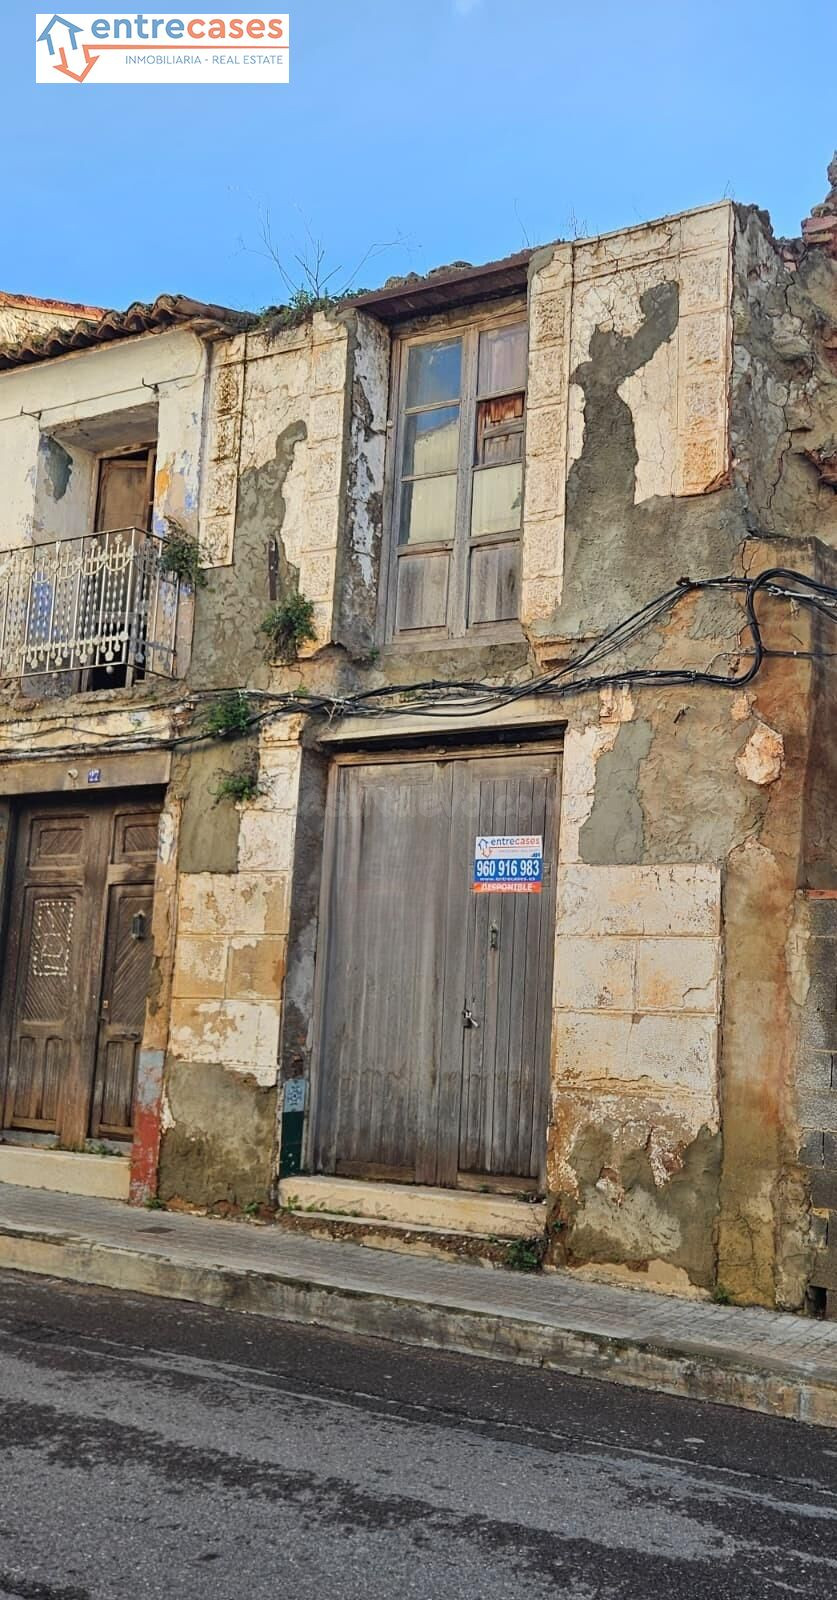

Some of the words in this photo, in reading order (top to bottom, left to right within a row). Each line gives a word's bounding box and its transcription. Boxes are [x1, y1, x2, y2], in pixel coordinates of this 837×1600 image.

[490, 837, 540, 846] entrecases
[476, 860, 496, 877] 960
[498, 860, 518, 876] 916
[520, 859, 540, 876] 983
[481, 883, 533, 891] DISPONIBLE
